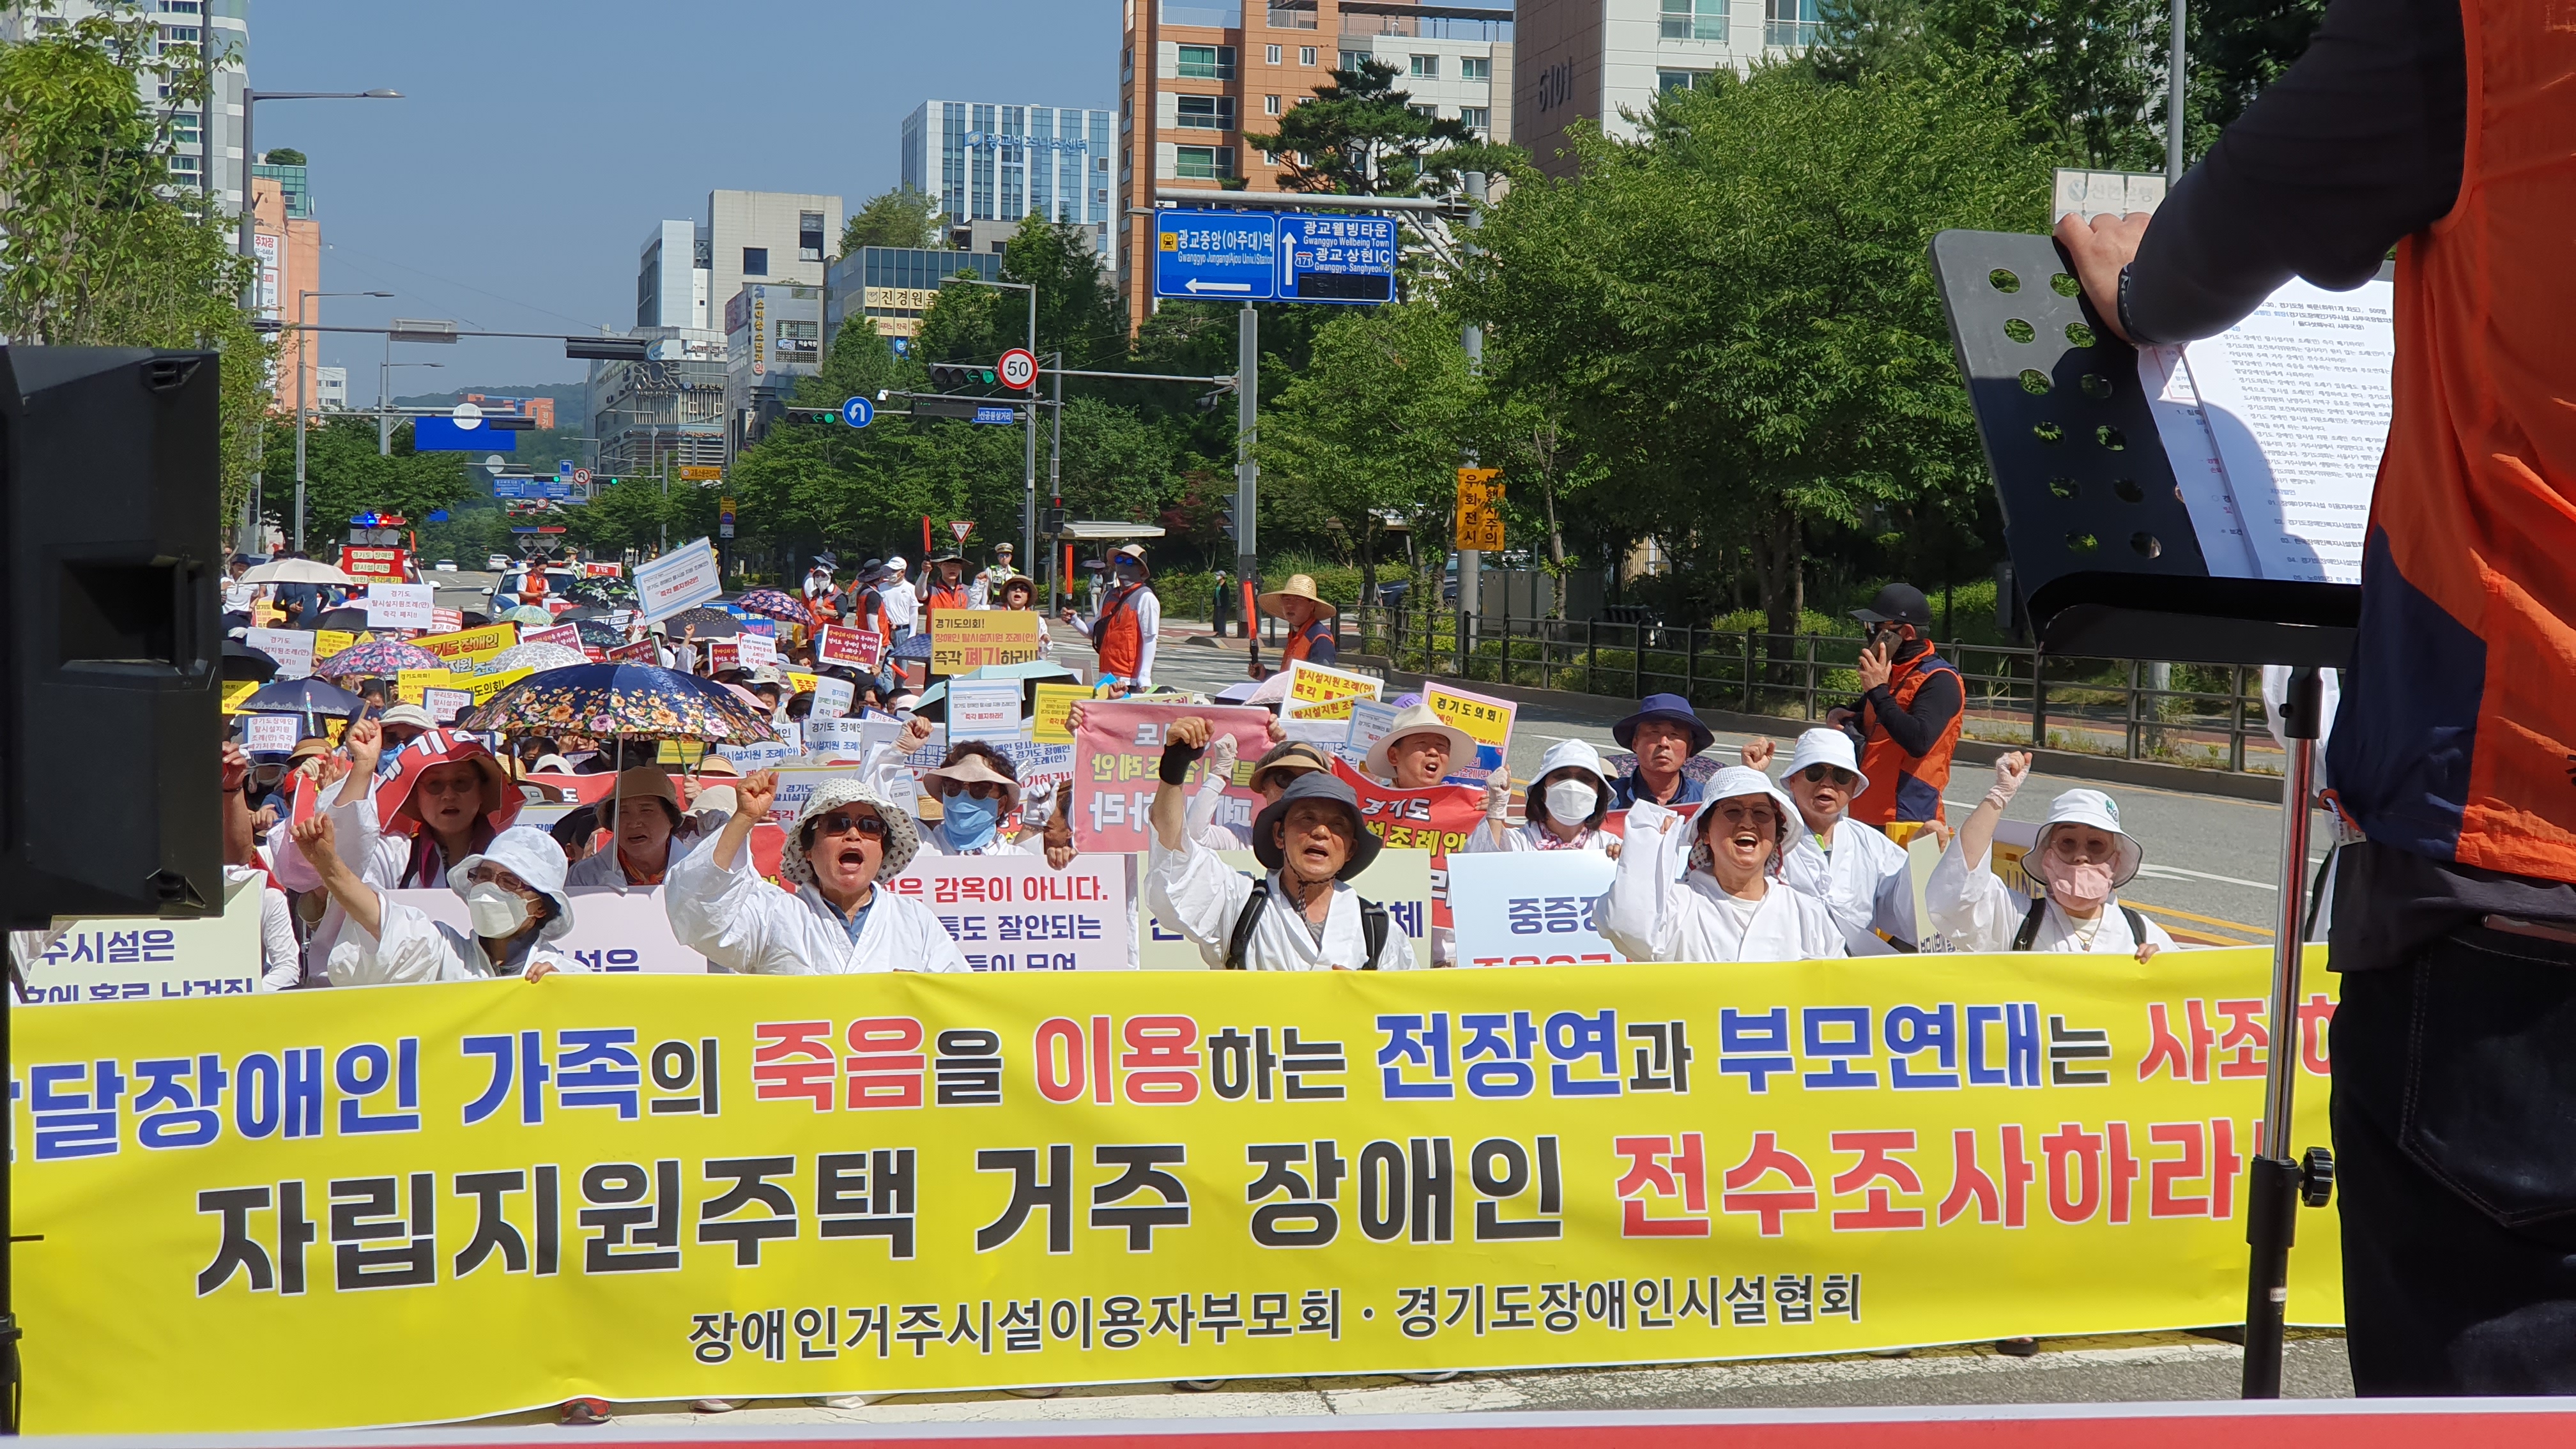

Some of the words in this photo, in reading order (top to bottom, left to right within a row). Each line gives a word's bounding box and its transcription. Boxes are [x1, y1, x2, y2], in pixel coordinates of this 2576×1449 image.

[986, 132, 1088, 154] 광교비즈니스센터
[1303, 221, 1388, 238] 광교웰빙타운
[256, 236, 273, 248] 주차장
[1178, 229, 1273, 252] 광교중앙(아주대)역
[1303, 236, 1338, 248] Gwanggyo
[1338, 236, 1370, 249] Wellbeing
[1372, 238, 1389, 247] Town
[1178, 251, 1206, 266] Gwanggyo
[1298, 257, 1310, 266] 171
[1007, 360, 1029, 377] 50
[1464, 474, 1478, 544] 우회전시
[353, 551, 372, 559] 경기도
[374, 551, 395, 559] 장애인
[353, 563, 374, 571] 탈시설
[376, 564, 390, 572] 지원
[661, 587, 672, 597] 즉각
[372, 600, 430, 608] 탈시설지원조례(안)
[935, 618, 985, 629] 경기도의회!
[461, 632, 499, 654] 장애인
[935, 632, 960, 643] 장애인
[962, 632, 1004, 643] 탈시설지원
[1006, 632, 1037, 643] 조례(안)
[935, 650, 962, 666] 즉각
[1298, 669, 1340, 688] 탈시설지원
[1342, 680, 1376, 693] 조례(안)
[1295, 684, 1317, 698] 즉각
[819, 709, 831, 717] 즉각
[1294, 703, 1340, 719] 탈시설지원
[1437, 697, 1503, 723] 경기도의회!
[812, 723, 835, 733] 경기도
[251, 734, 277, 742] 조례(안)
[279, 734, 293, 742] 즉각
[1016, 747, 1043, 758] 경기도
[1044, 745, 1071, 755] 장애인
[769, 809, 795, 821] 즉각
[1361, 797, 1431, 822] 경기도
[935, 876, 1013, 903] 감옥이
[1023, 875, 1108, 902] 아니다.
[998, 914, 1101, 941] 잘안되는
[10, 1036, 420, 1162] 달장애인
[463, 1027, 719, 1125] 가족의
[752, 1016, 1004, 1114] 죽음을
[1034, 1013, 1347, 1107] 이용하는
[1376, 1007, 1692, 1100] 전장연과
[1719, 1000, 2112, 1094] 부모연대는
[196, 1148, 917, 1298] 자립지원주택
[974, 1144, 1192, 1255] 거주
[1245, 1134, 1563, 1249] 장애인
[689, 1287, 1342, 1365] 장애인거주시설이용자부모회
[1395, 1271, 1862, 1338] 경기도장애인시설협회
